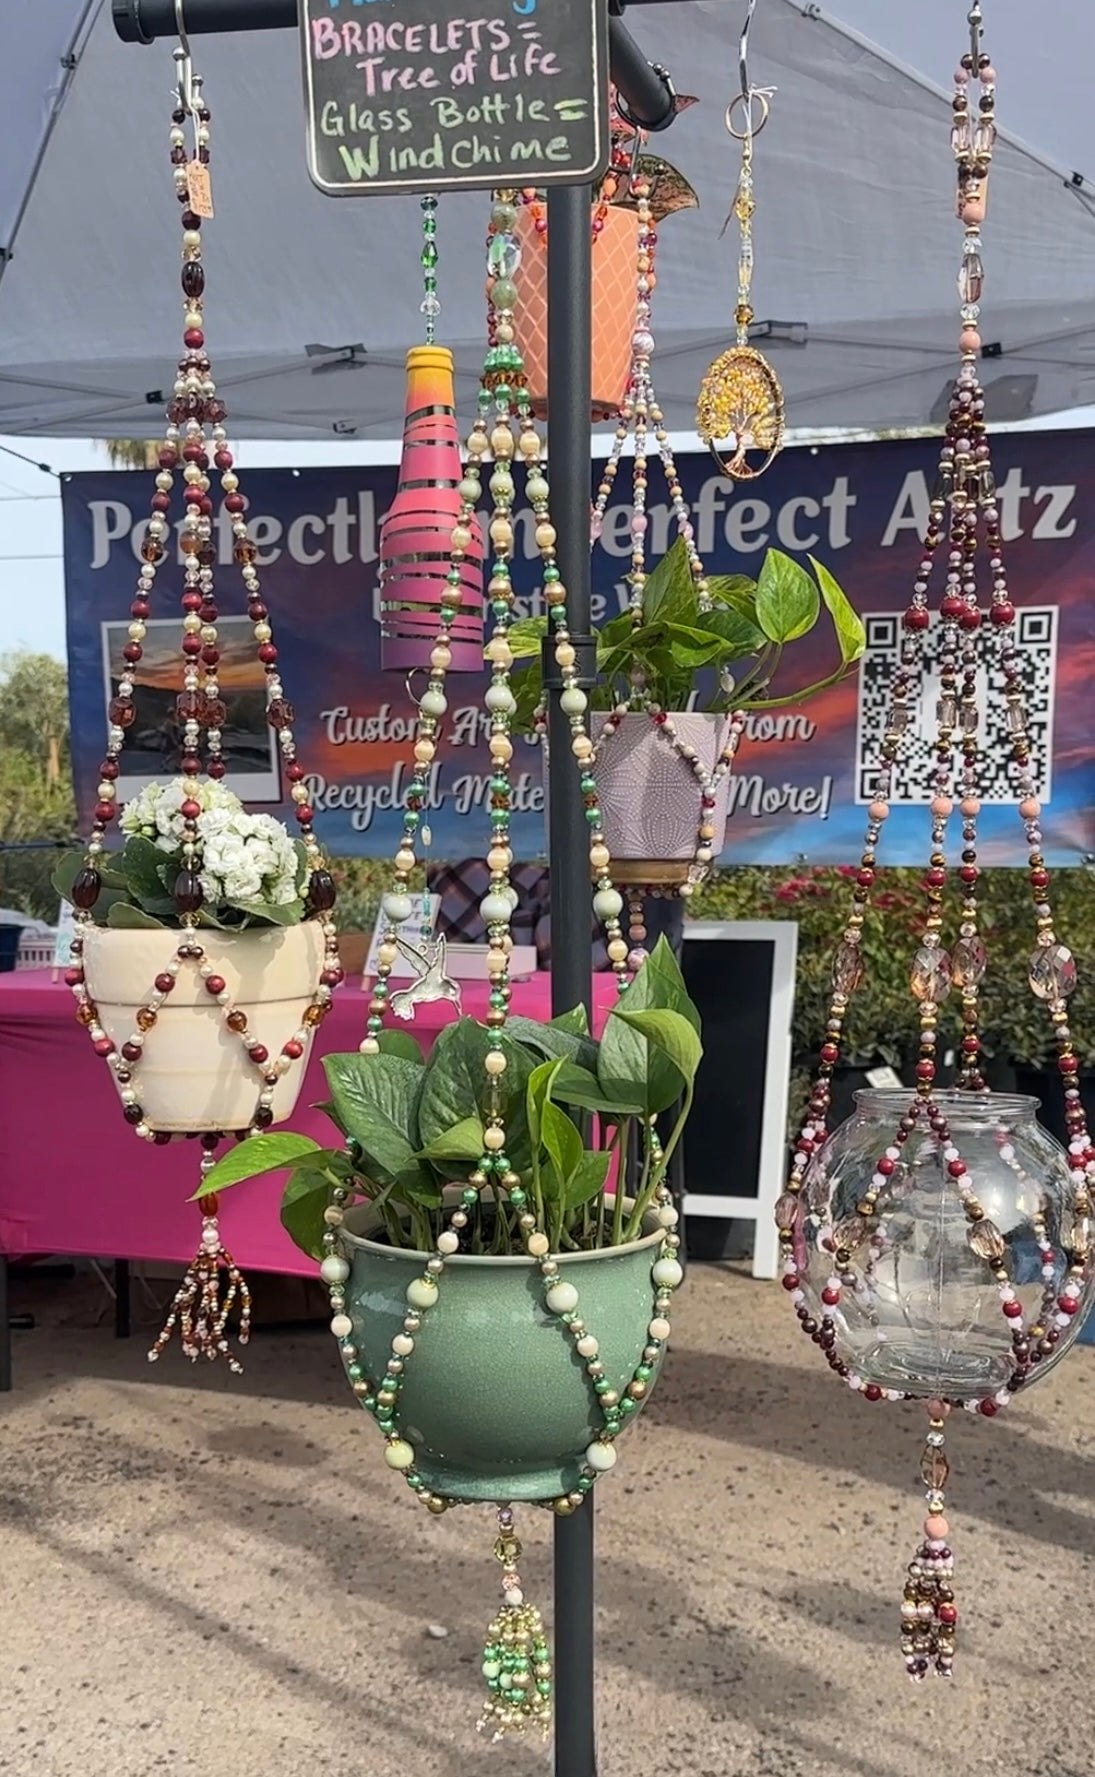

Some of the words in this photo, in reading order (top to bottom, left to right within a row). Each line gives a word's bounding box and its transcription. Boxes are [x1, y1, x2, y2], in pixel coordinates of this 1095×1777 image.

[356, 56, 441, 97] Tree
[450, 49, 477, 87] of
[490, 43, 562, 82] Life
[320, 100, 413, 138] Glass
[87, 490, 380, 570] Pefectl
[880, 467, 1077, 547] Atz
[736, 713, 816, 742] rom
[727, 775, 832, 820] More!
